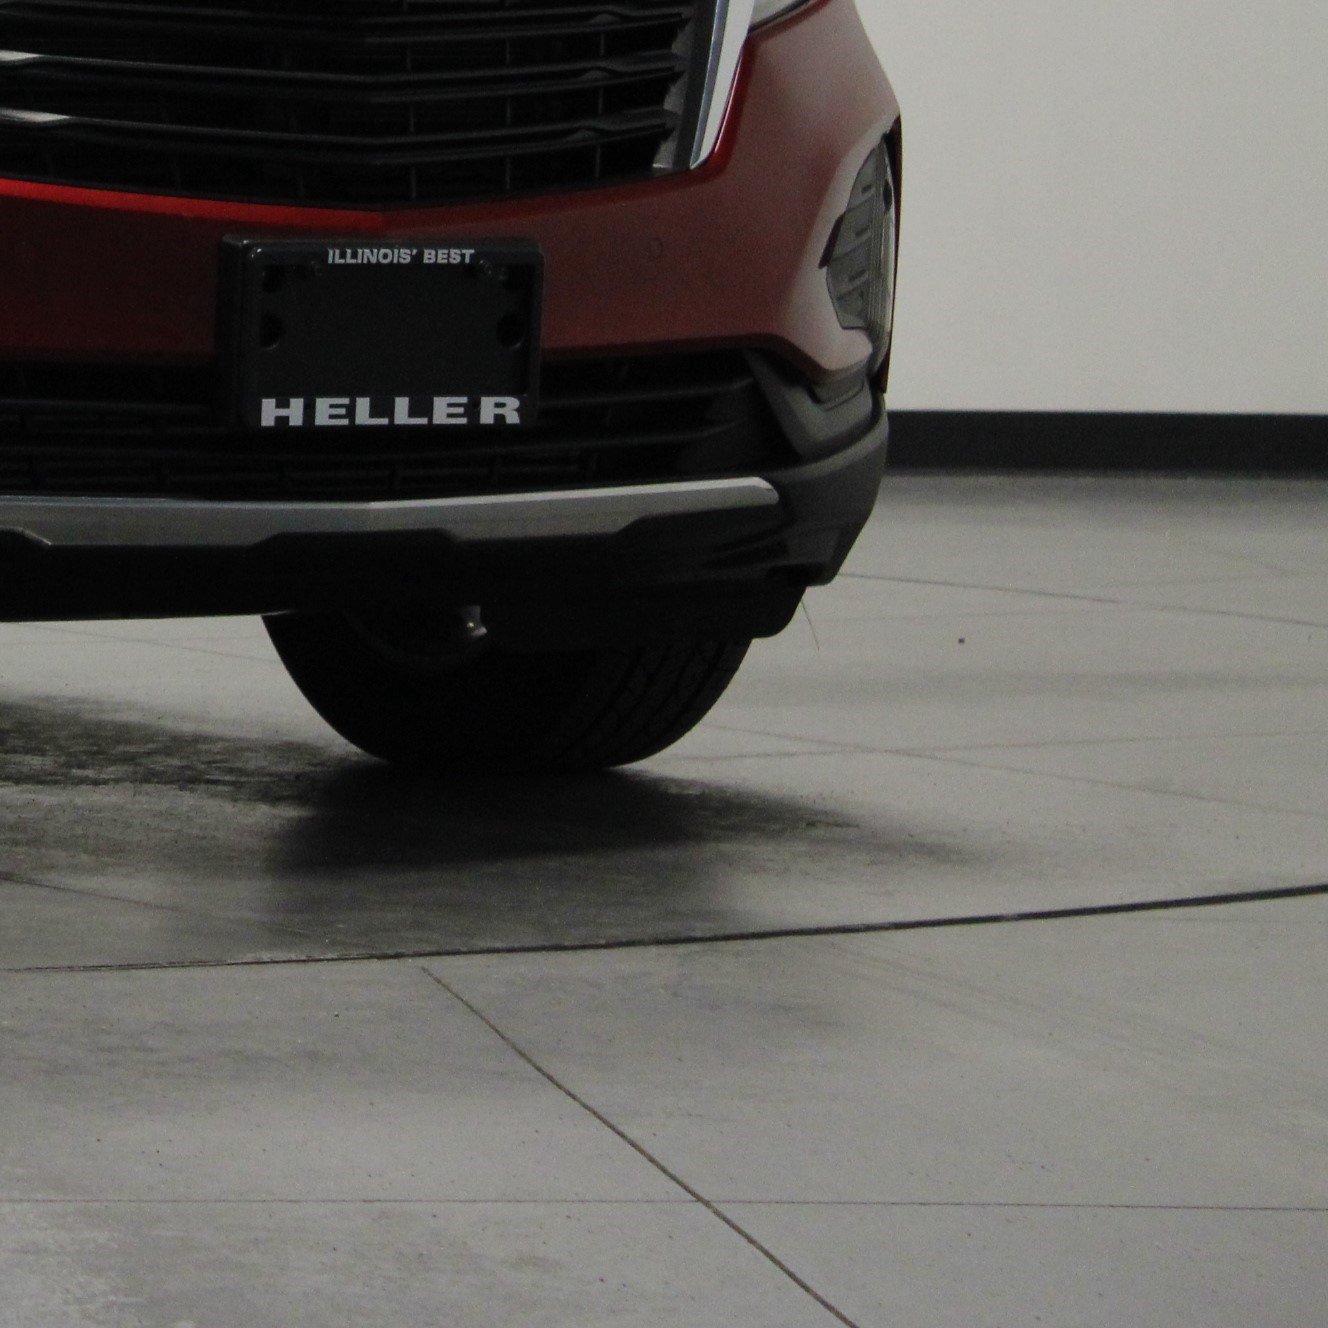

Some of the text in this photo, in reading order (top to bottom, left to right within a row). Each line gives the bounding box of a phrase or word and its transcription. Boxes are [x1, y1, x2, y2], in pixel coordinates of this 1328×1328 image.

[328, 248, 475, 264] ILLINOIS' BEST
[260, 396, 521, 427] HELLER
